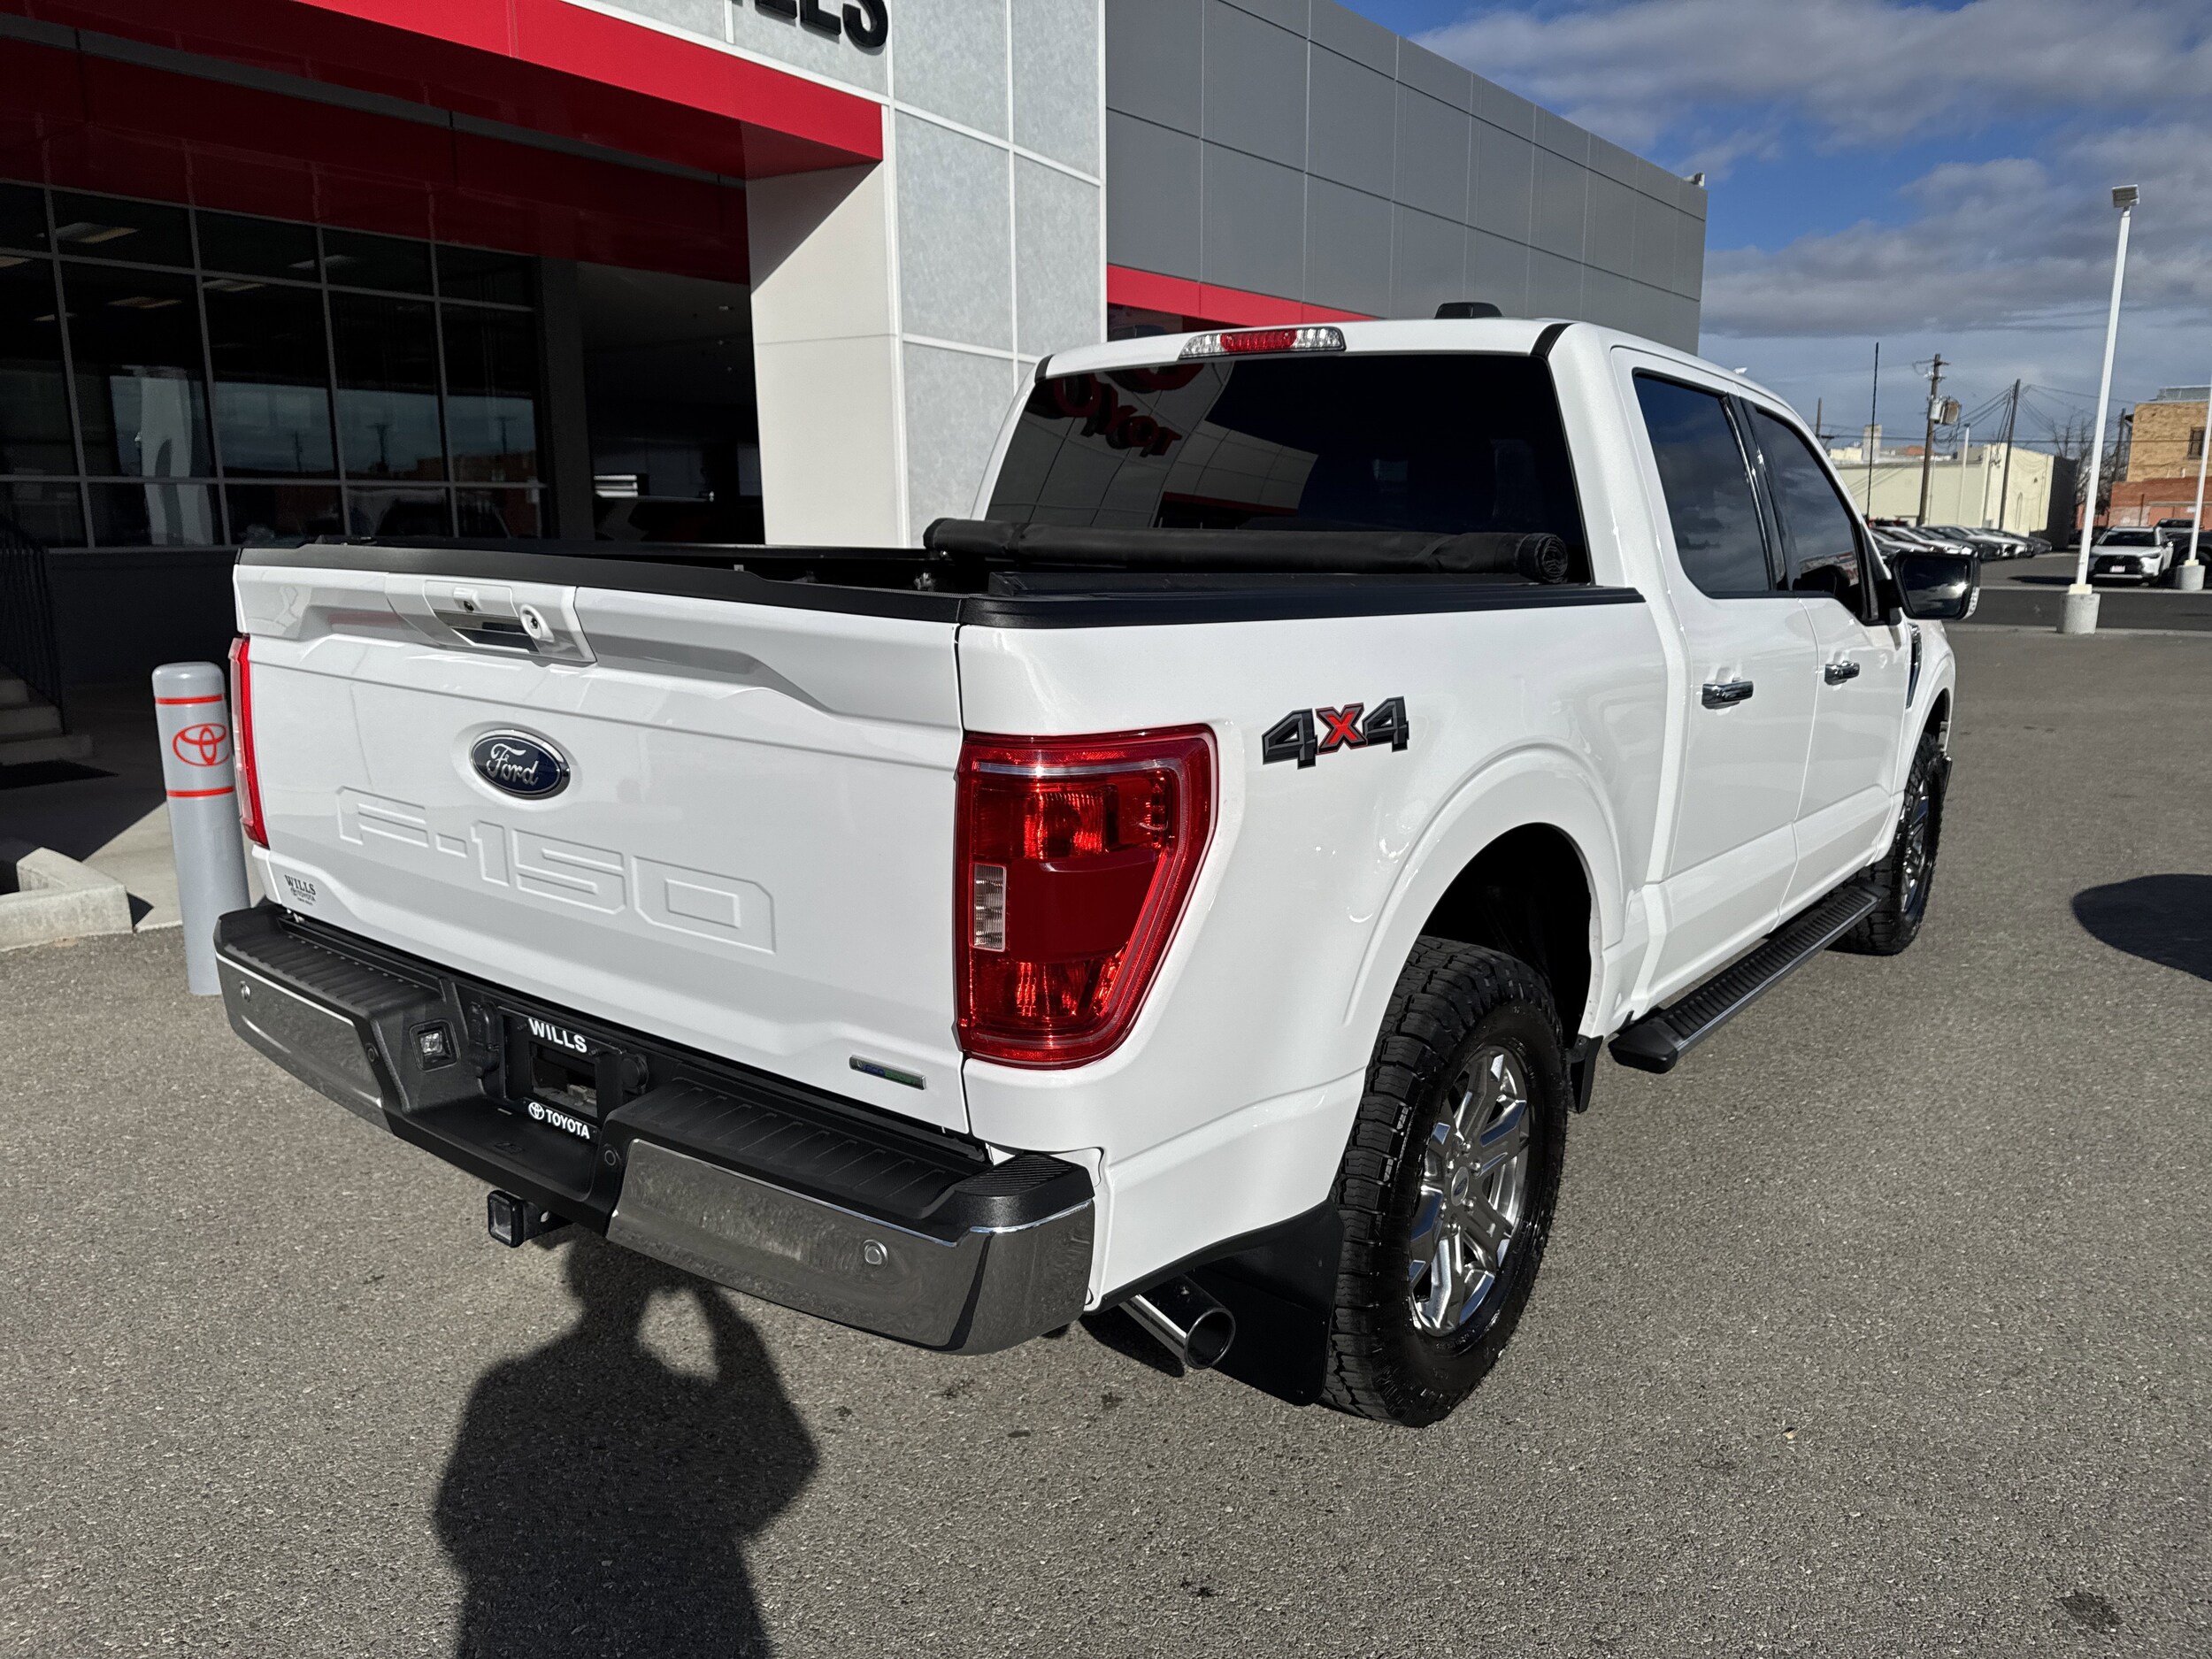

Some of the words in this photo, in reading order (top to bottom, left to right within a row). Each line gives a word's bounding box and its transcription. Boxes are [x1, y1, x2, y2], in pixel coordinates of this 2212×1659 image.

[486, 743, 539, 786] Ford
[284, 874, 316, 895] WILLS
[336, 786, 776, 955] F-150
[528, 1018, 588, 1053] WILLS
[545, 1109, 590, 1140] TOYOTA
